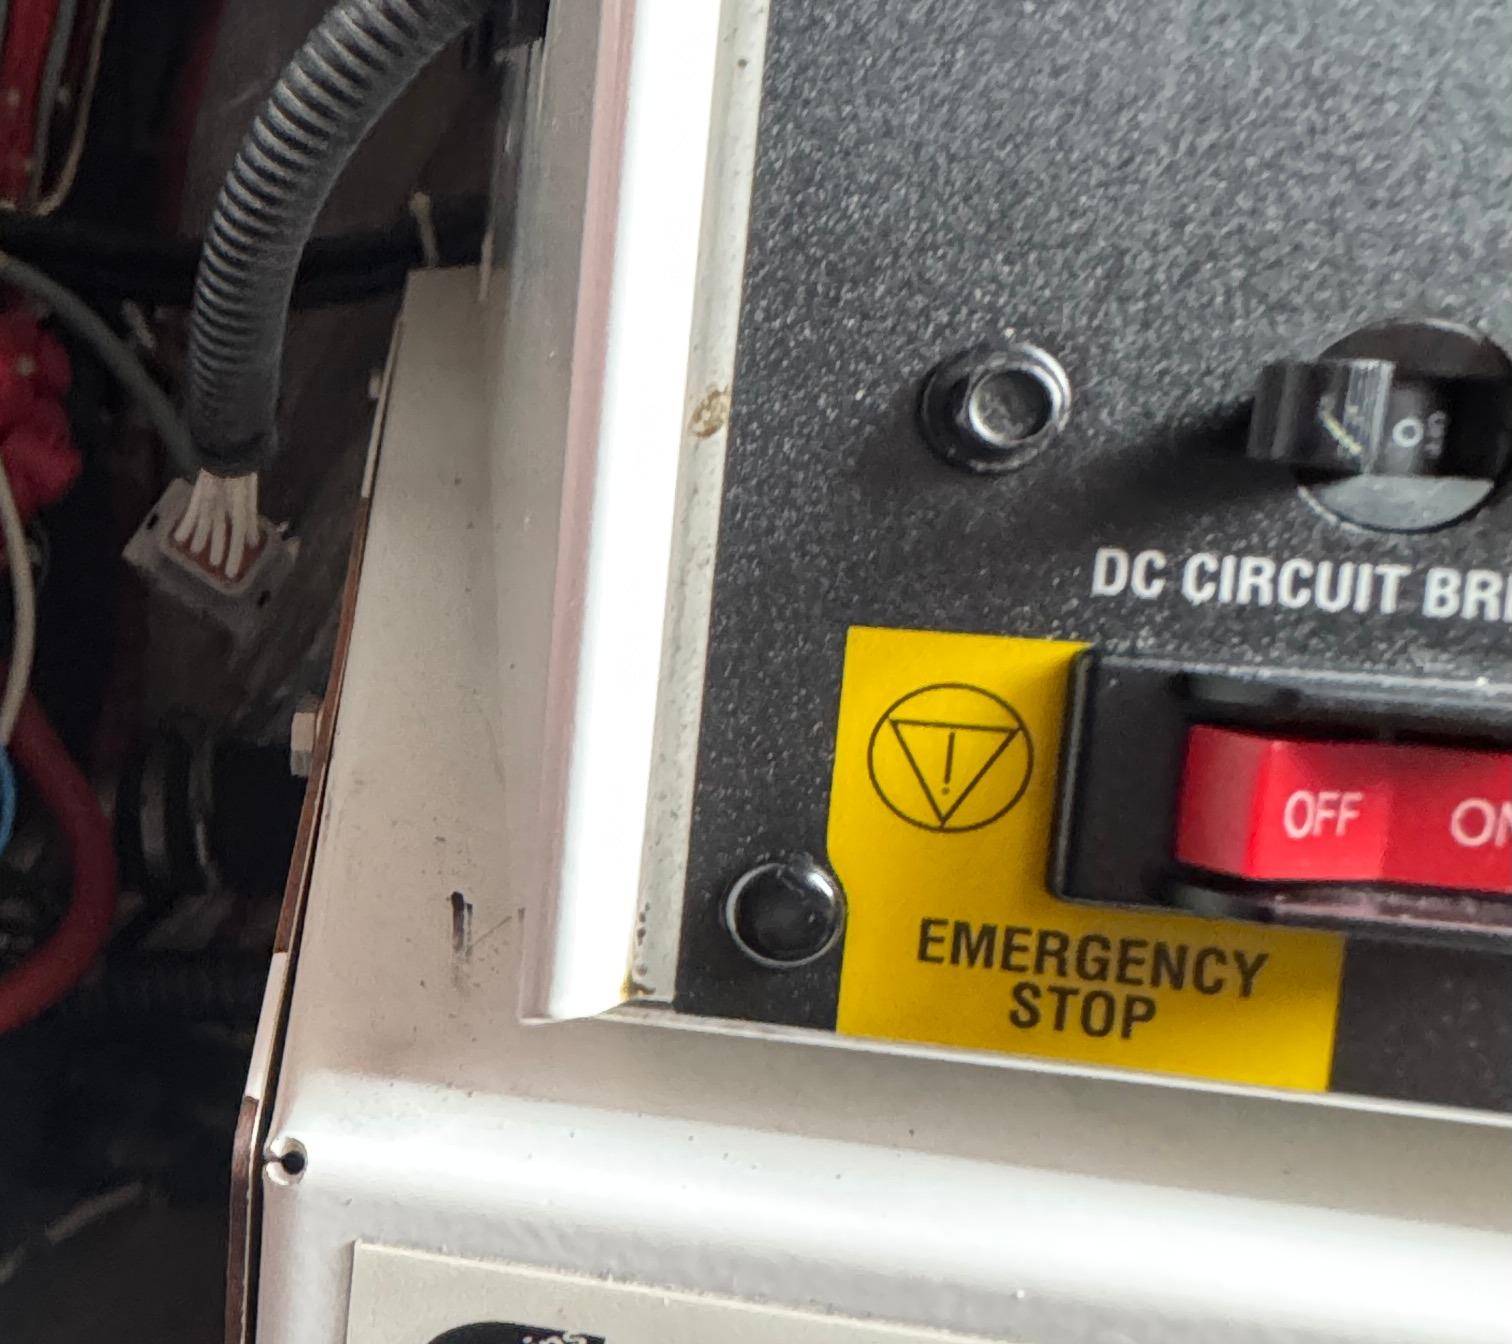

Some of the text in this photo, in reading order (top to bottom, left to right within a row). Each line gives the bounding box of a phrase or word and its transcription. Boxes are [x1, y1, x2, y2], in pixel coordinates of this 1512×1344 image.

[1092, 550, 1512, 624] DC CIRCUIT BR
[1282, 788, 1364, 840] OFF
[916, 918, 1272, 999] EMERGENCY
[1008, 982, 1158, 1039] STOP
